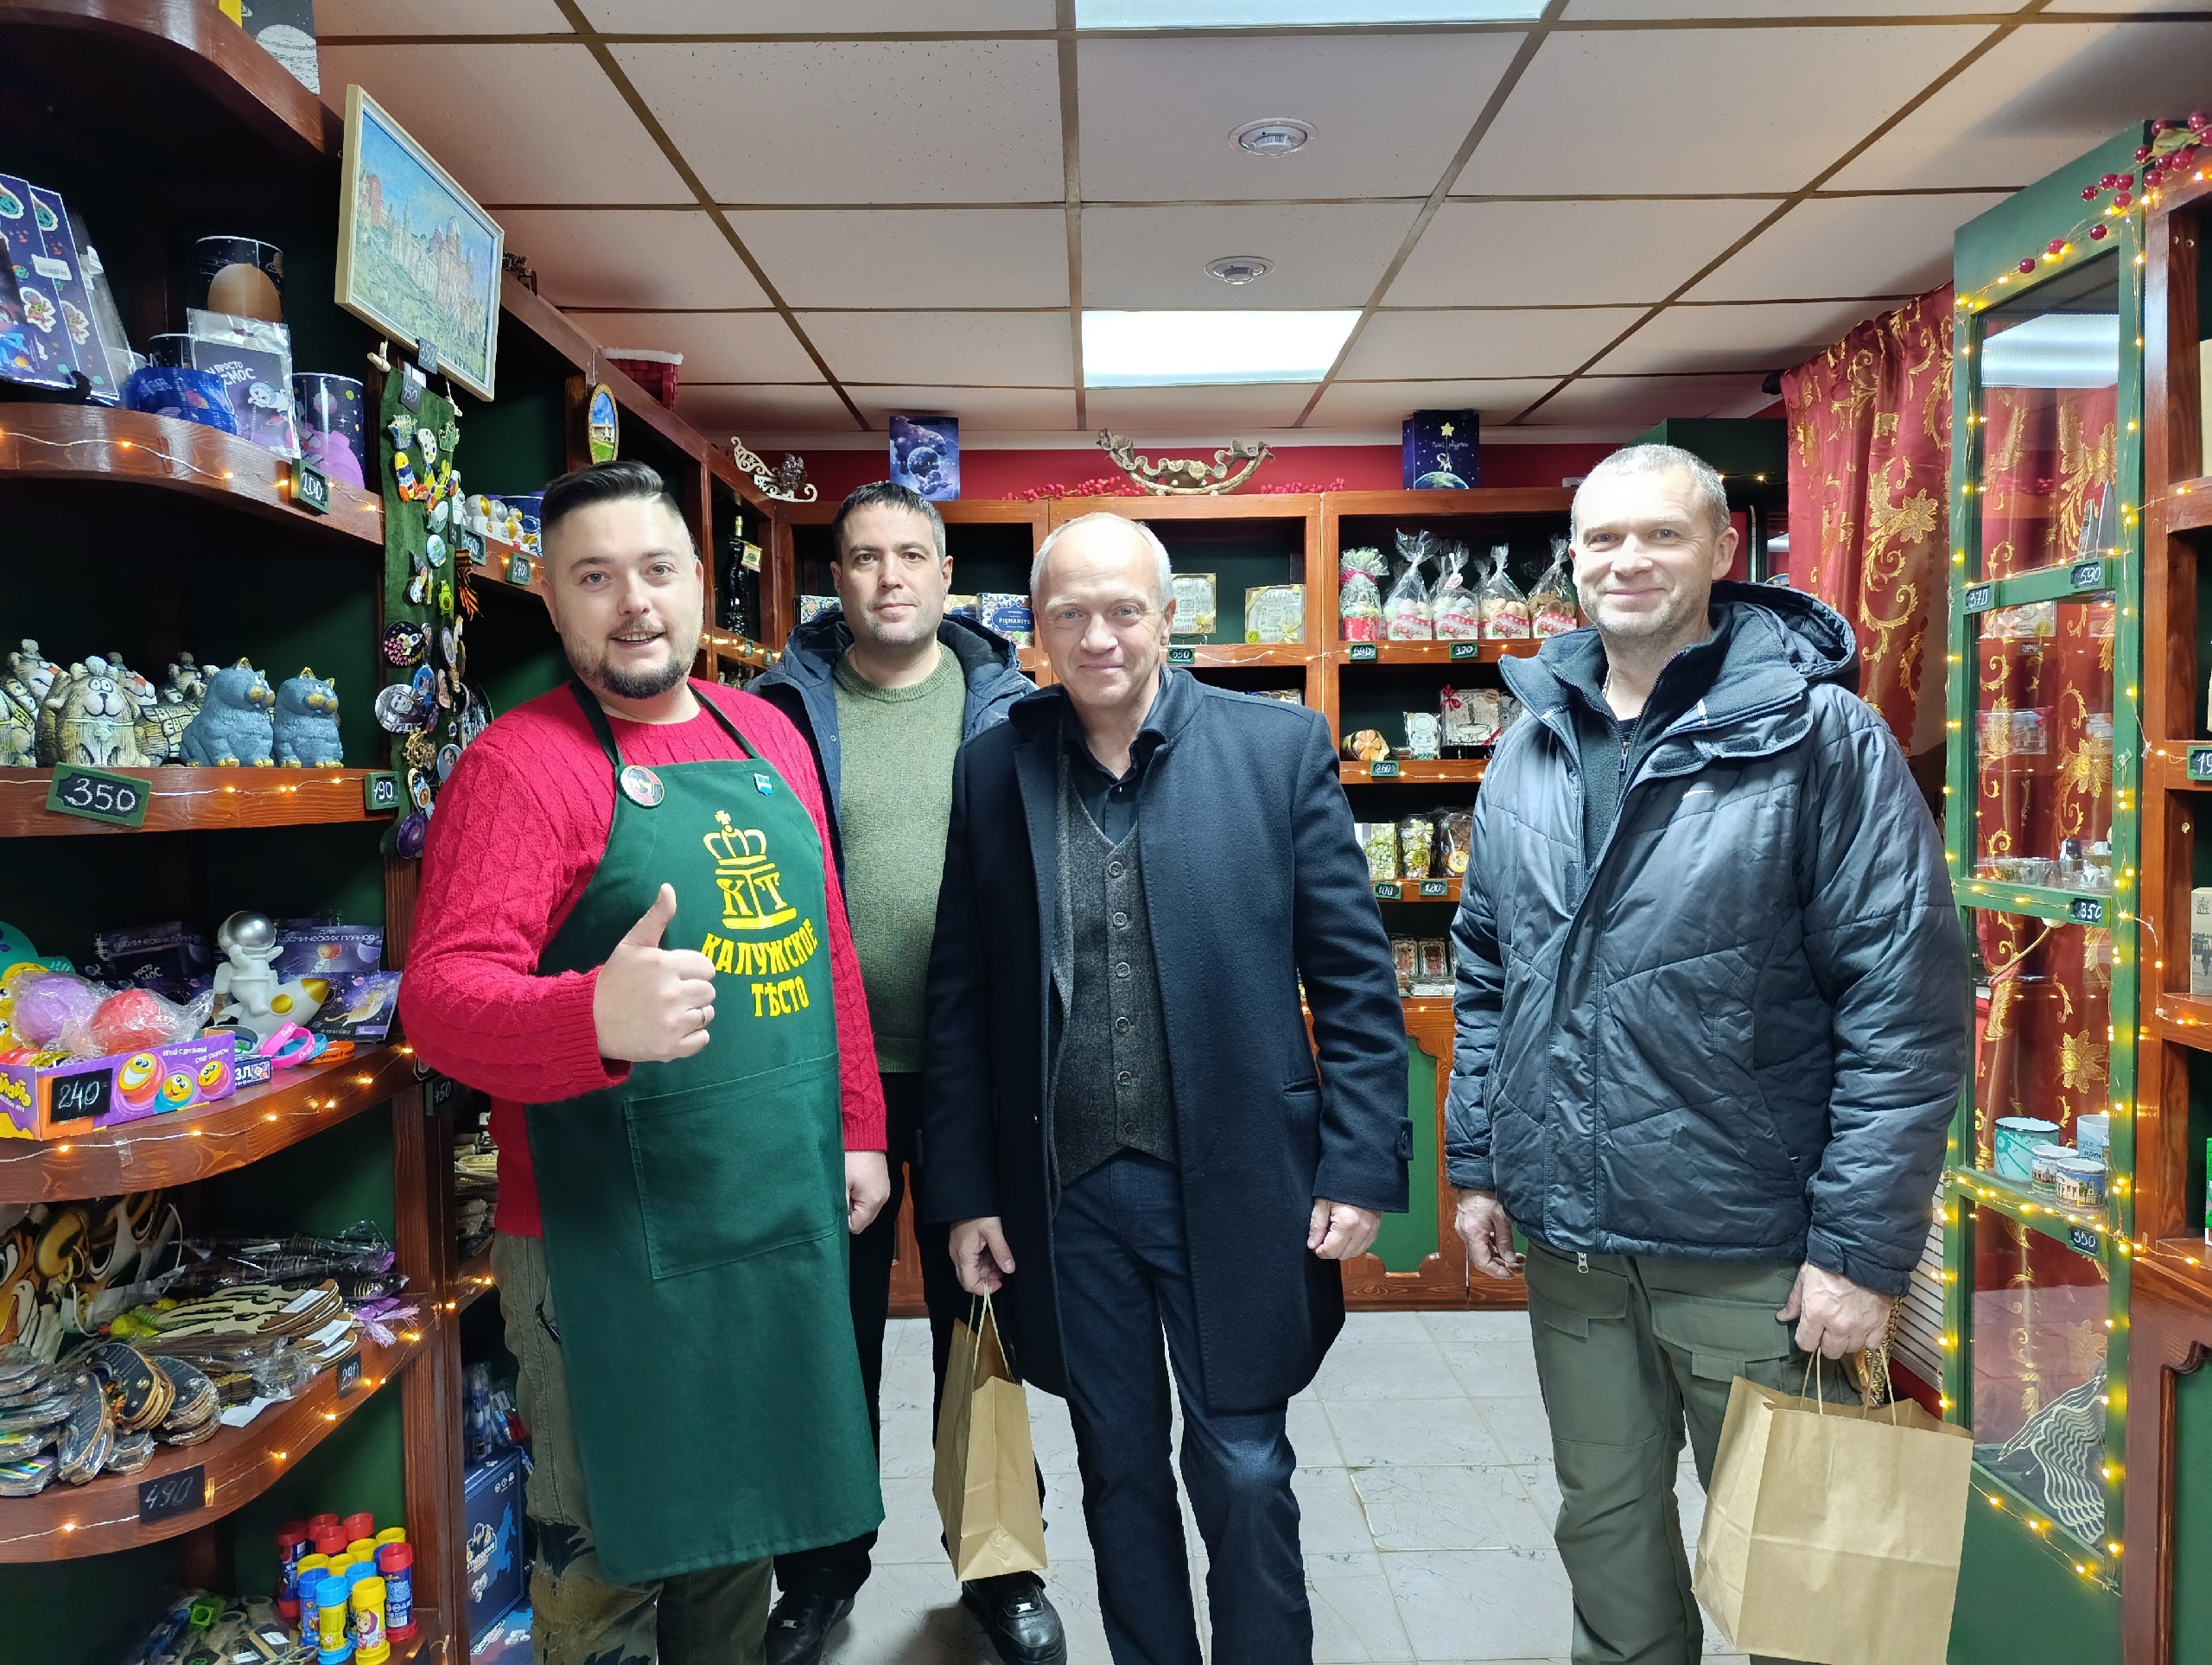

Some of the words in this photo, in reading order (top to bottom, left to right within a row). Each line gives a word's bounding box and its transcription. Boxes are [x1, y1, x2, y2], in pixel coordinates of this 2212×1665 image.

[2079, 566, 2102, 585] 590
[2196, 752, 2212, 775] 19
[64, 778, 137, 812] 350
[701, 918, 819, 975] КАЛУЖСКОЕ
[57, 1080, 100, 1110] 240
[144, 1476, 194, 1509] 490
